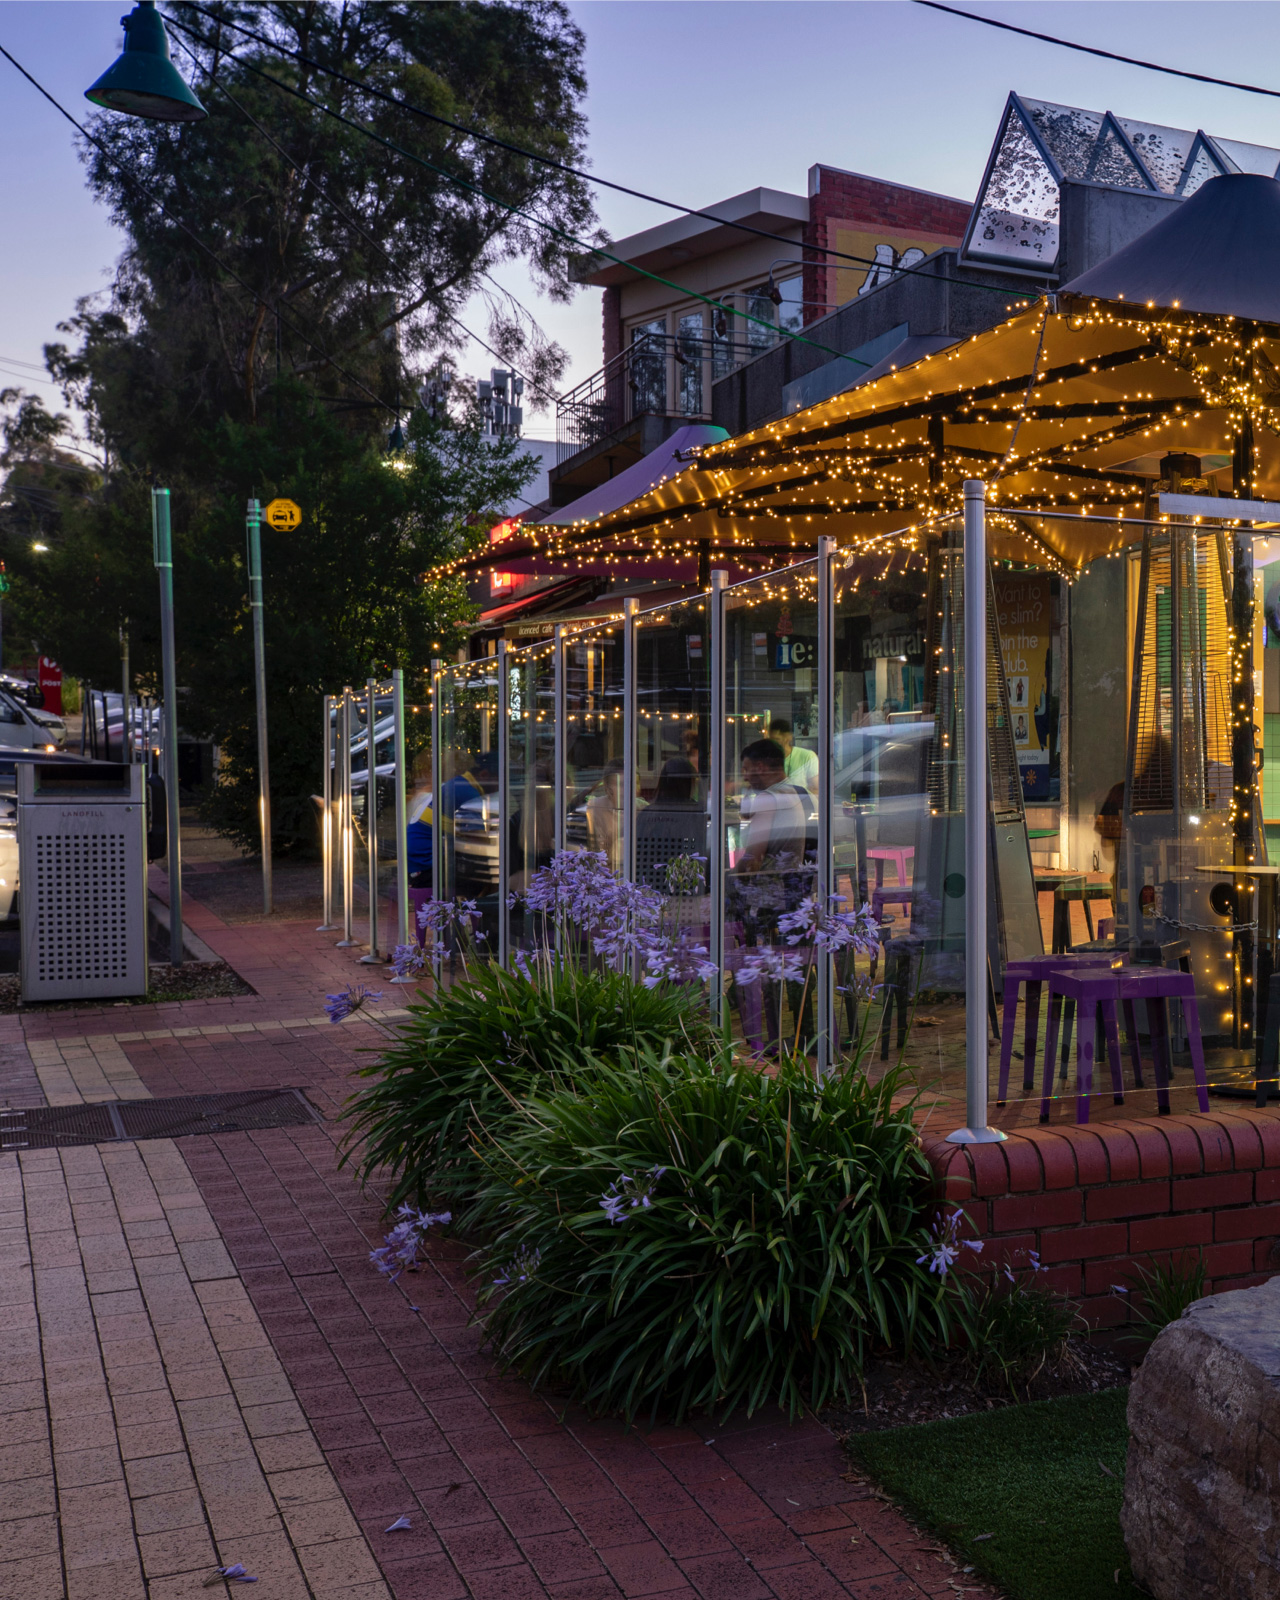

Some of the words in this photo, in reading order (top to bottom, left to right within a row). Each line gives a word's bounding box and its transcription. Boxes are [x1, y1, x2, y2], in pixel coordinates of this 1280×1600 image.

[1028, 584, 1041, 601] to
[1010, 601, 1043, 625] slim?
[541, 624, 554, 634] cafe
[1018, 628, 1039, 649] the
[862, 632, 922, 659] natural
[62, 810, 105, 818] LANDFILL
